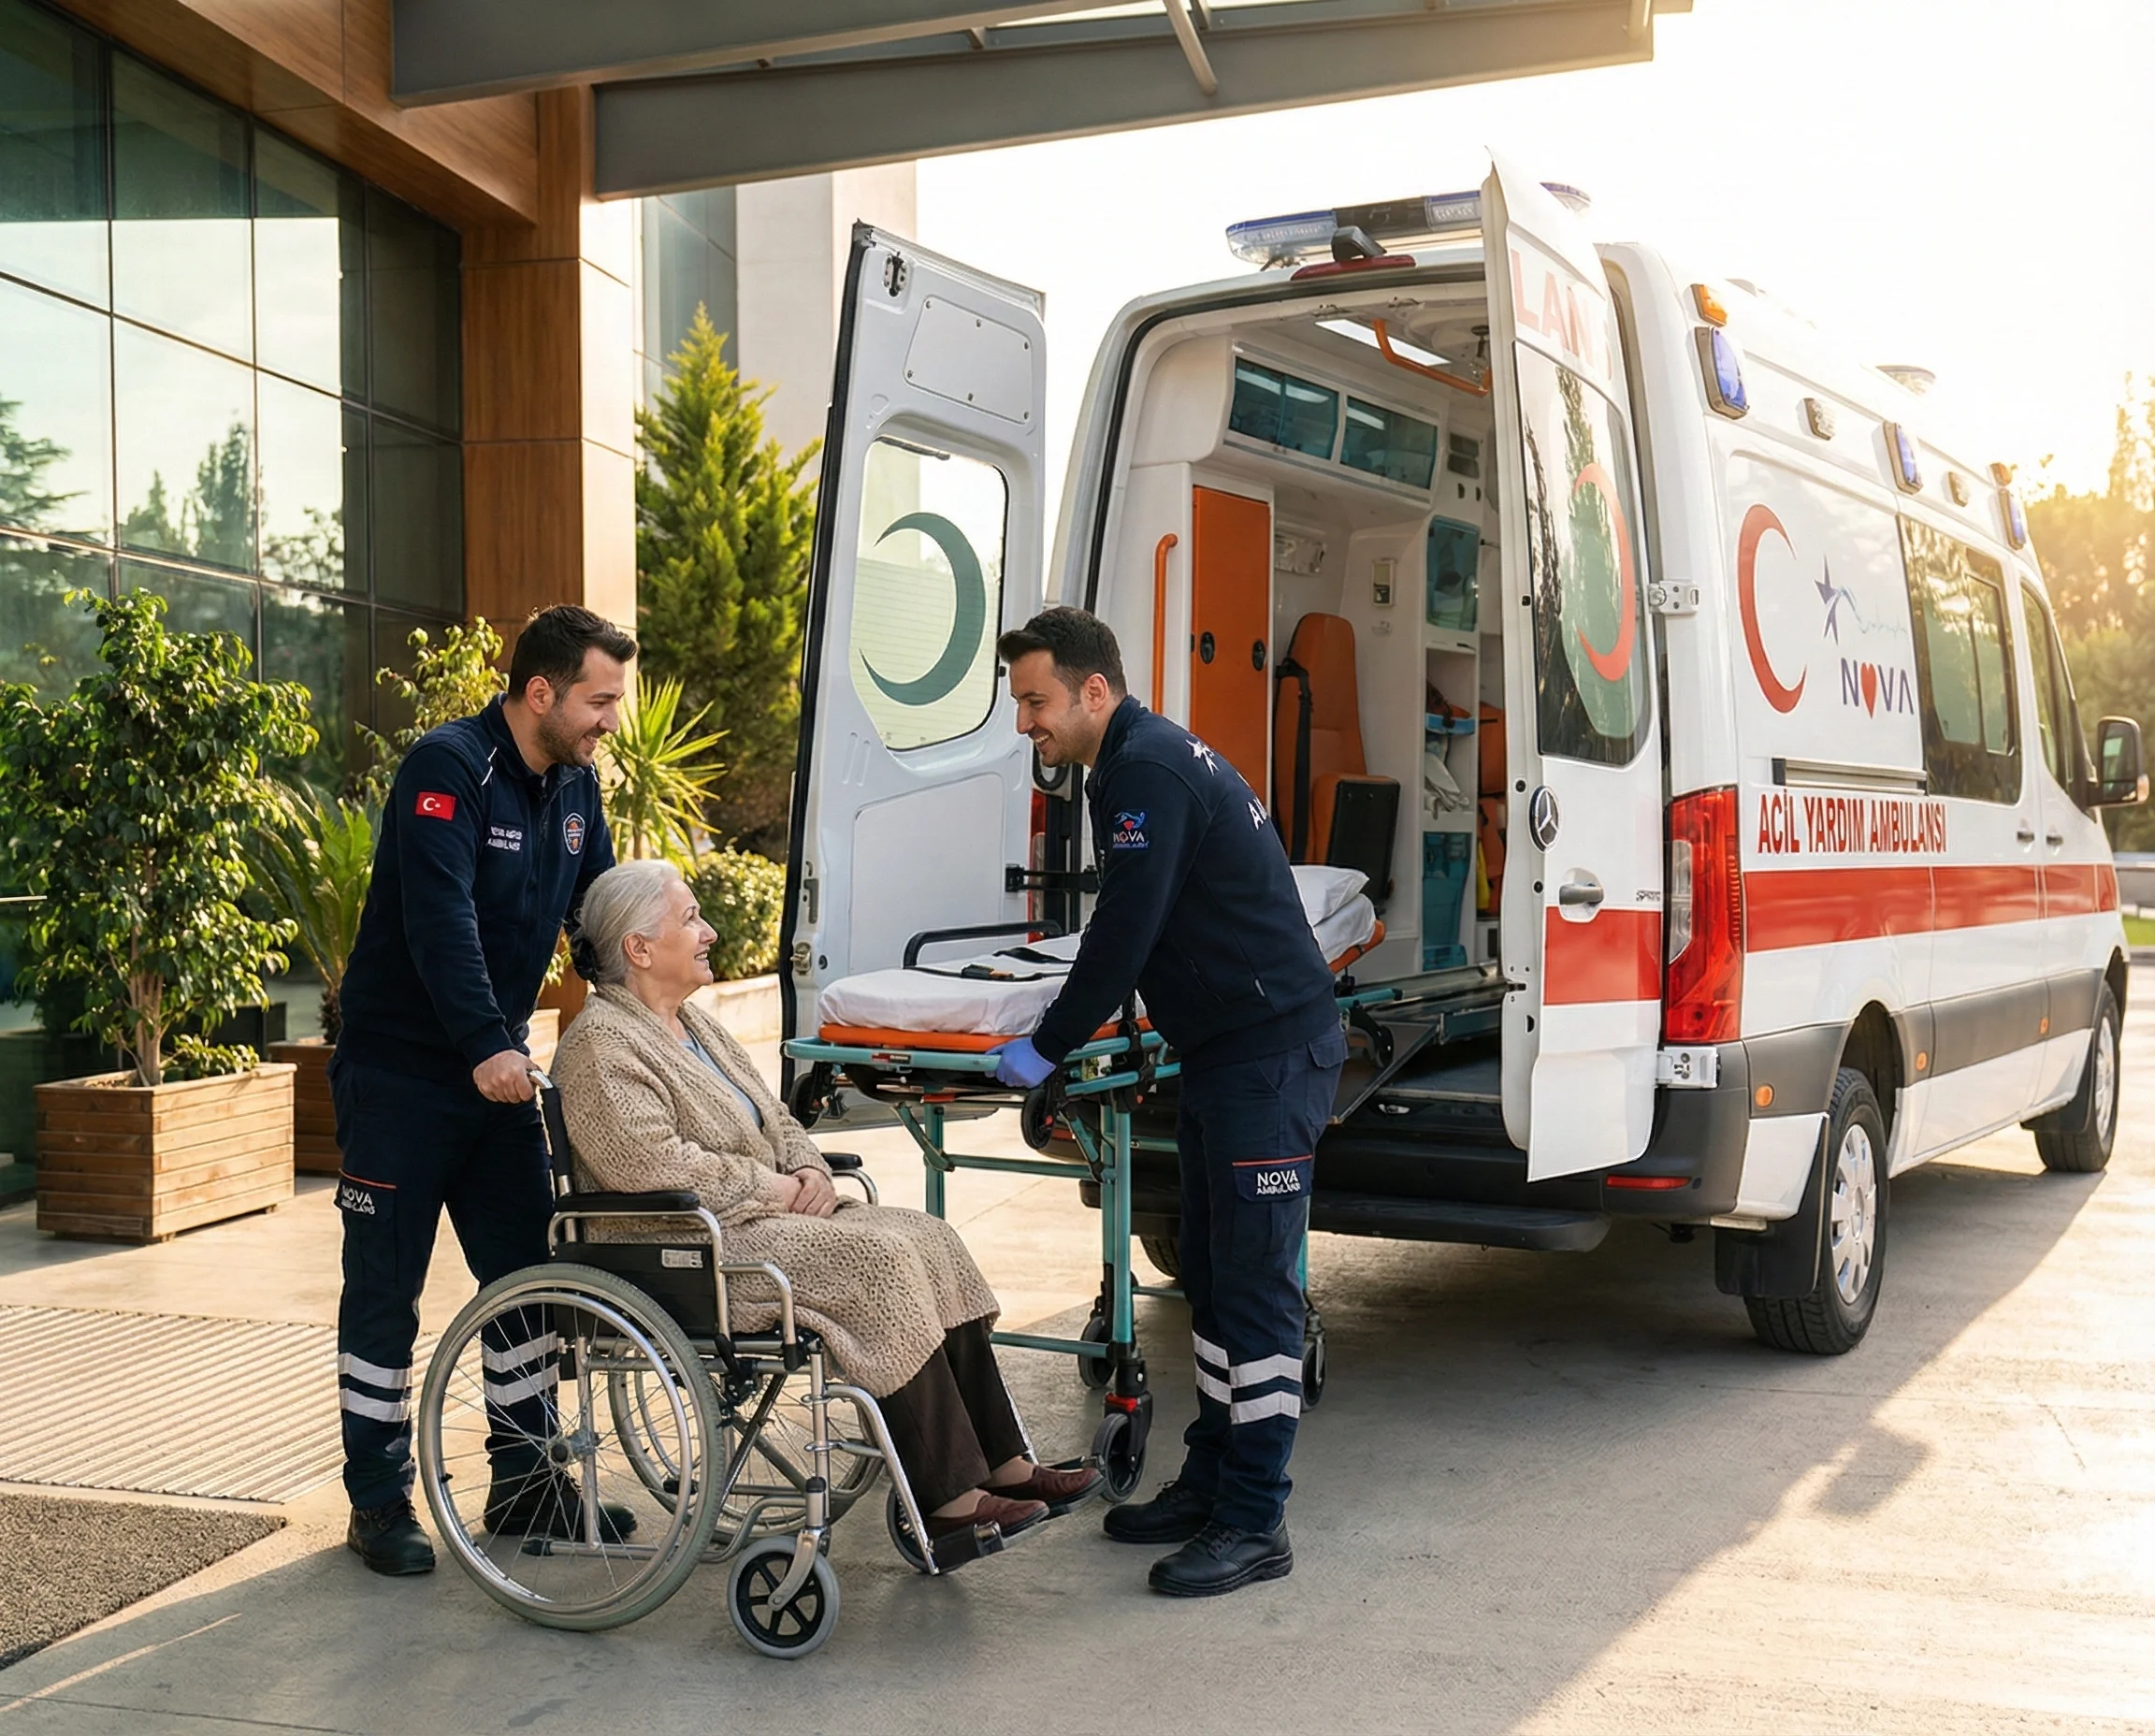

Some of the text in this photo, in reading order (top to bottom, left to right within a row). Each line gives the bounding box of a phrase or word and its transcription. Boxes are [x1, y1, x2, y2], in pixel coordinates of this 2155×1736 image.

[1803, 796, 1865, 853] YARDIM
[1870, 800, 1946, 854] AMBULANSI
[1257, 1169, 1299, 1187] NOVA
